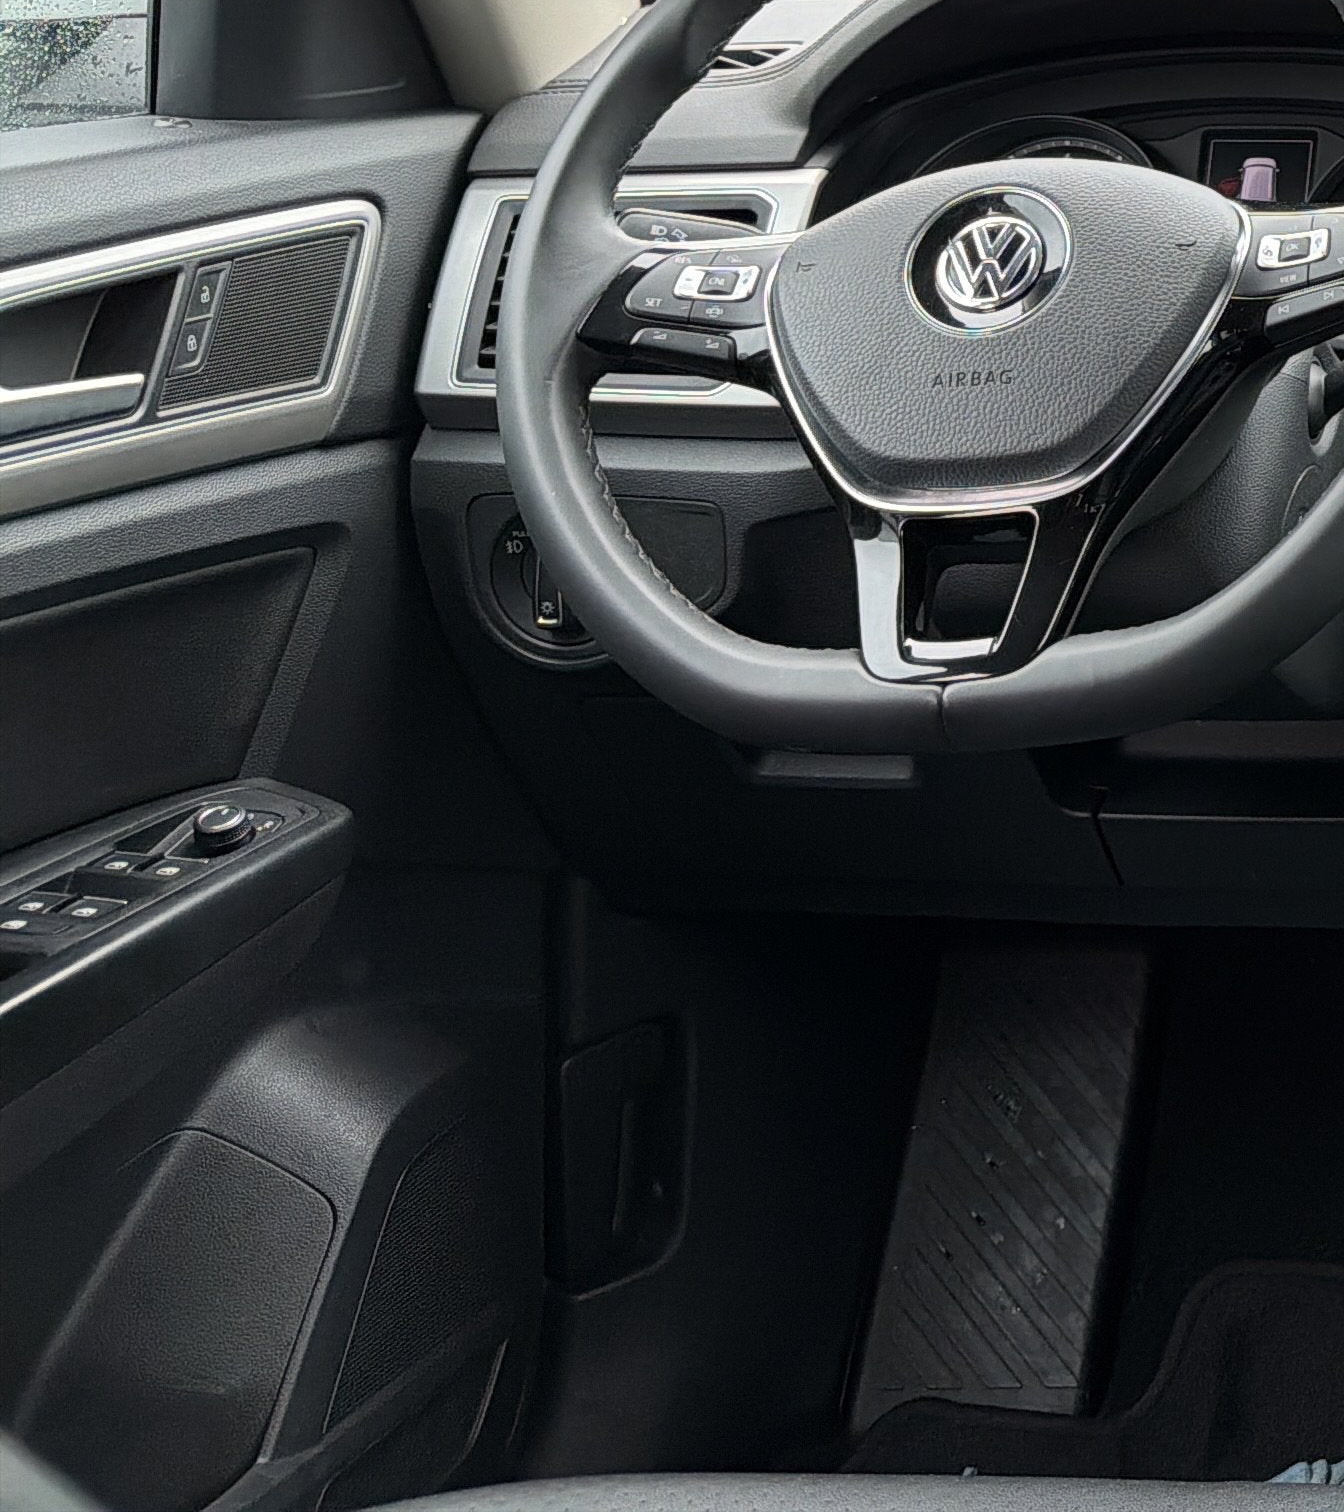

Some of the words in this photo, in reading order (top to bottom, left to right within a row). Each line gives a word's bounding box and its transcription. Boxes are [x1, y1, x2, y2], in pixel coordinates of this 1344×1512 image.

[1279, 273, 1297, 284] VIEW
[644, 297, 663, 307] SET
[933, 369, 1013, 388] AIRBAG
